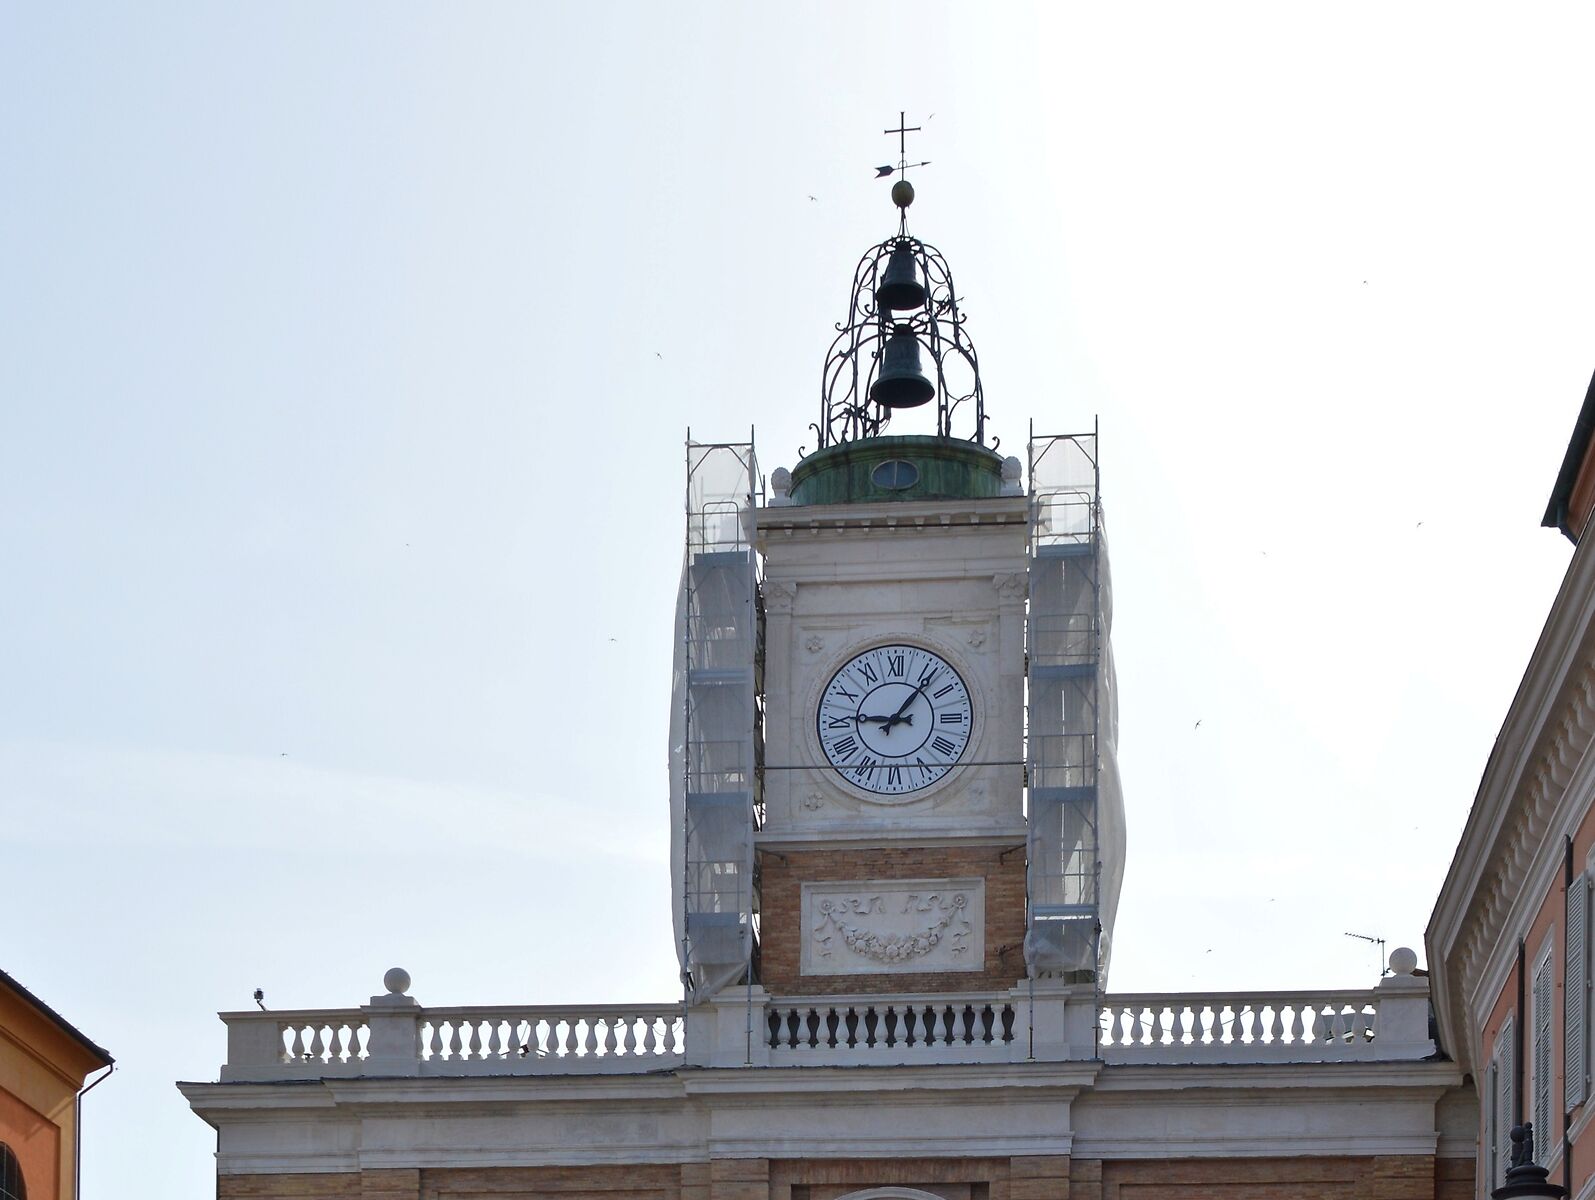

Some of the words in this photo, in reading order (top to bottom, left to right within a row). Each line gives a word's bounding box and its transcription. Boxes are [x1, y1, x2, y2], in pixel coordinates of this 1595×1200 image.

[857, 662, 878, 686] XI
[887, 655, 904, 677] XII
[836, 685, 859, 703] X
[933, 683, 954, 699] II
[828, 715, 850, 729] IX
[940, 713, 963, 724] III
[833, 735, 859, 763] VIII
[854, 755, 877, 781] VII
[887, 763, 902, 785] VI
[916, 757, 932, 778] V
